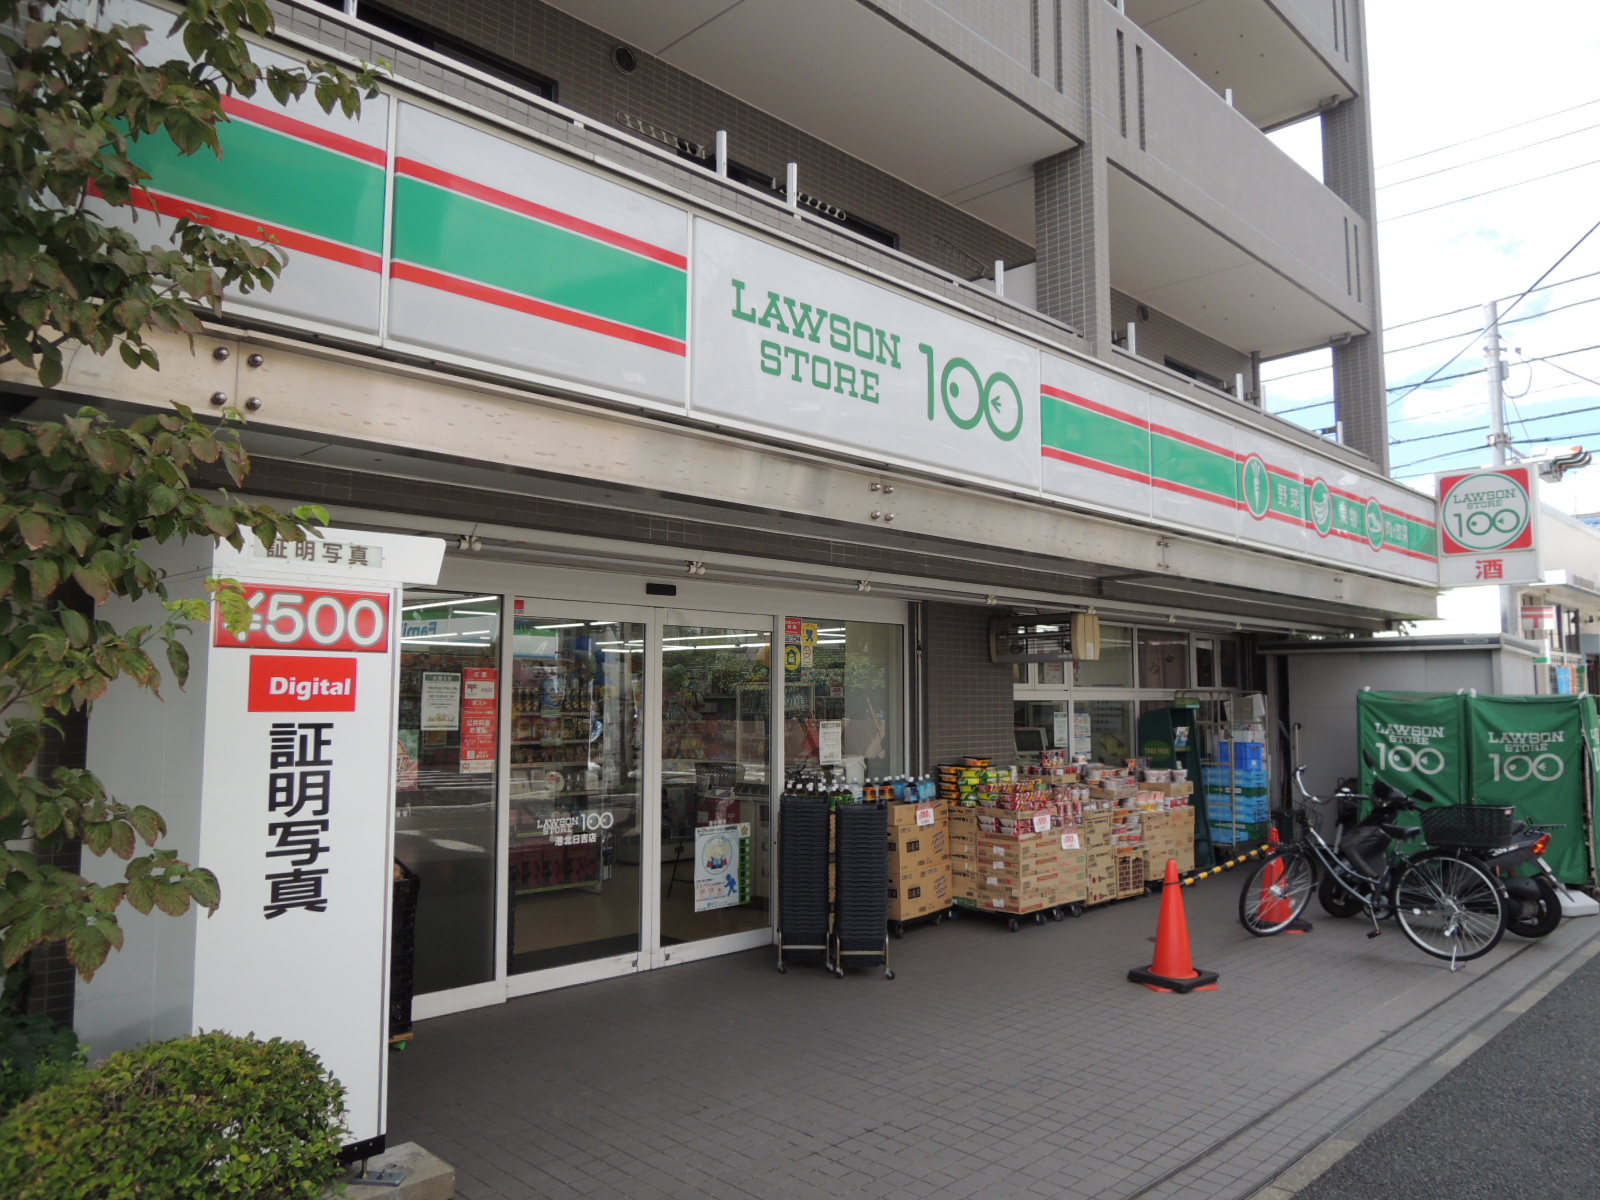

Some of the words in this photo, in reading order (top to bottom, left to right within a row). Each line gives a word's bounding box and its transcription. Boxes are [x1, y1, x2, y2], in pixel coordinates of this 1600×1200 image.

[731, 278, 901, 369] LAWSON
[760, 339, 880, 404] STORE
[918, 342, 1023, 442] 100
[1277, 483, 1300, 511] 野菜
[1453, 488, 1517, 504] LAWSON
[1466, 500, 1503, 510] STORE
[1453, 508, 1521, 538] 100
[266, 538, 369, 567] 証明写真
[1475, 559, 1503, 580] 酒
[269, 676, 353, 701] Digital
[1374, 722, 1445, 738] LAWSON
[1389, 735, 1430, 745] STORE
[1488, 731, 1565, 744] LAWSON
[1375, 742, 1445, 775] 100
[1505, 743, 1548, 752] STORE
[1488, 753, 1564, 782] 100
[263, 722, 334, 920] 証明写真
[537, 816, 579, 829] LAWSON
[543, 825, 573, 835] STORE
[581, 812, 614, 831] 100
